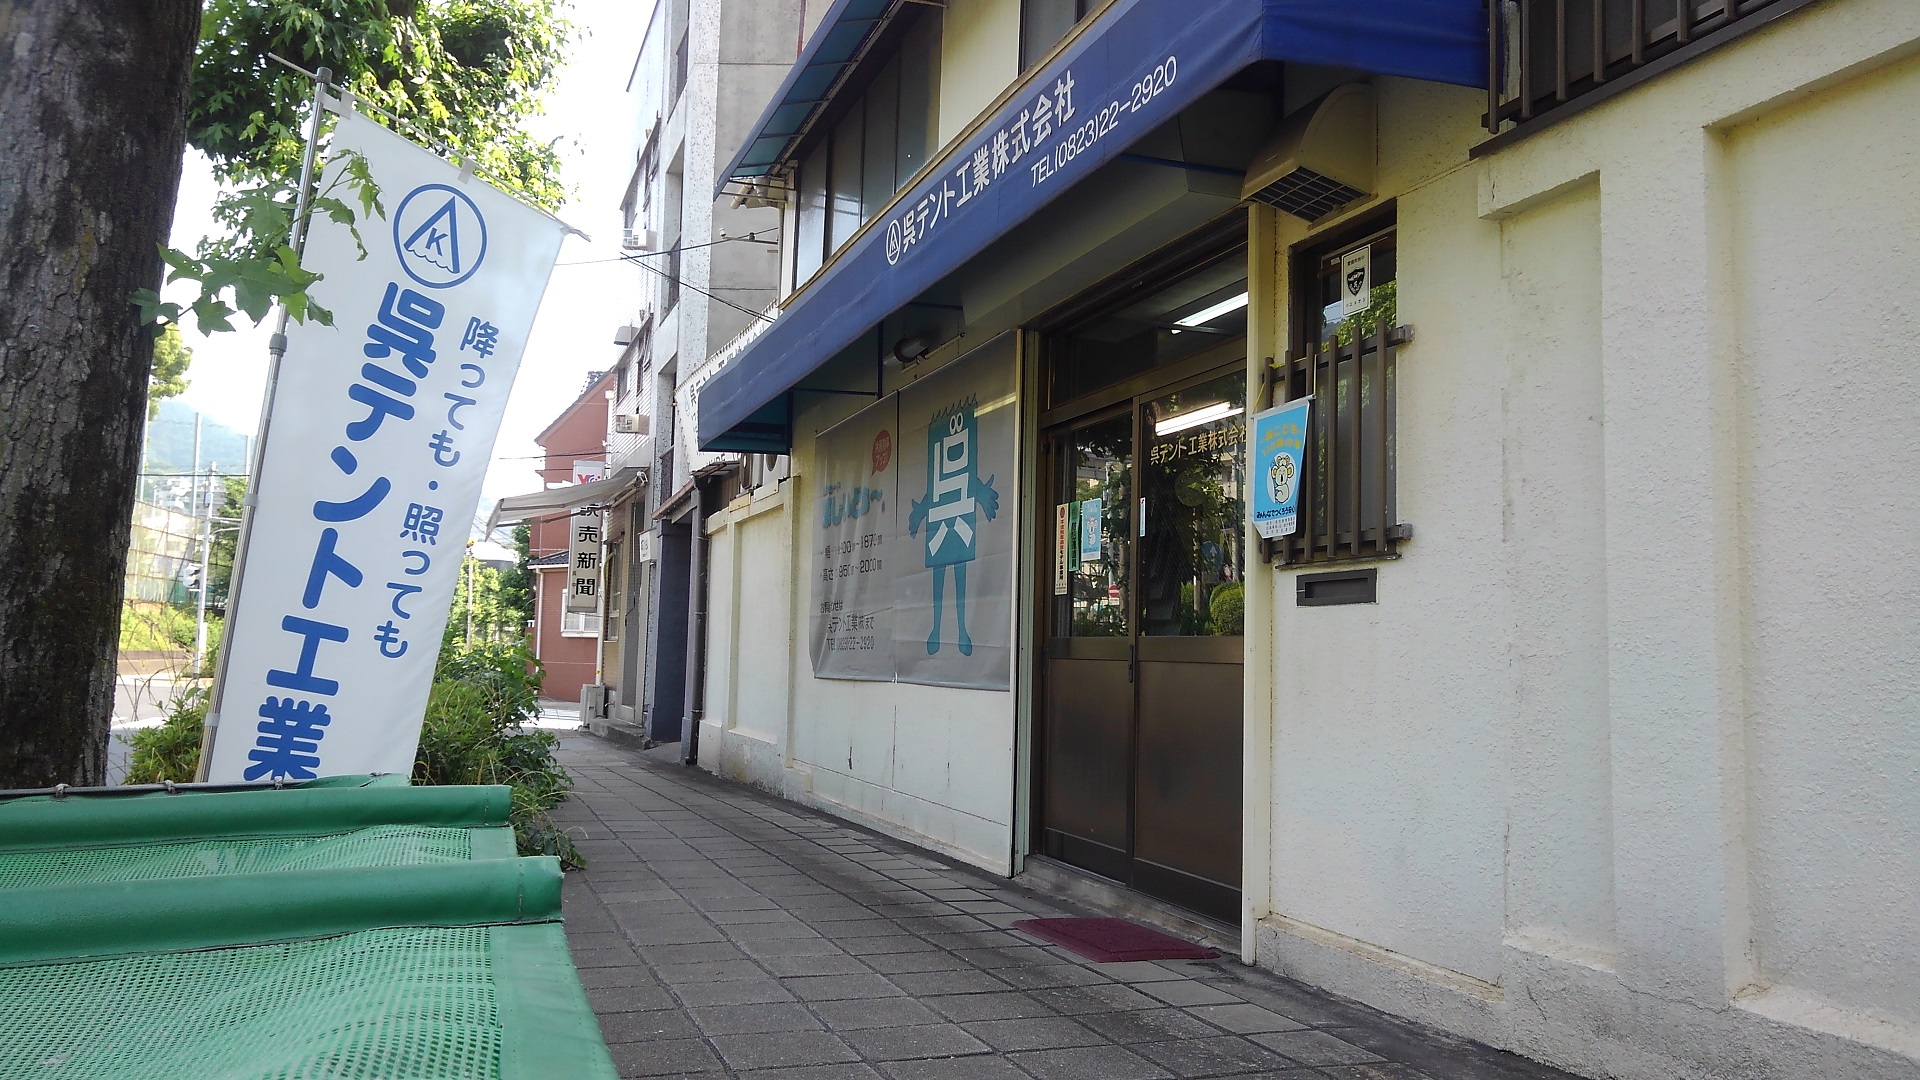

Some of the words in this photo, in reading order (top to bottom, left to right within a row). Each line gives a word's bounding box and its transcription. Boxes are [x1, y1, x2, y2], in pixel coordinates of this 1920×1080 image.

[902, 69, 1076, 254] 呉テント工業株式会社
[373, 316, 500, 659] 降っても・照っても
